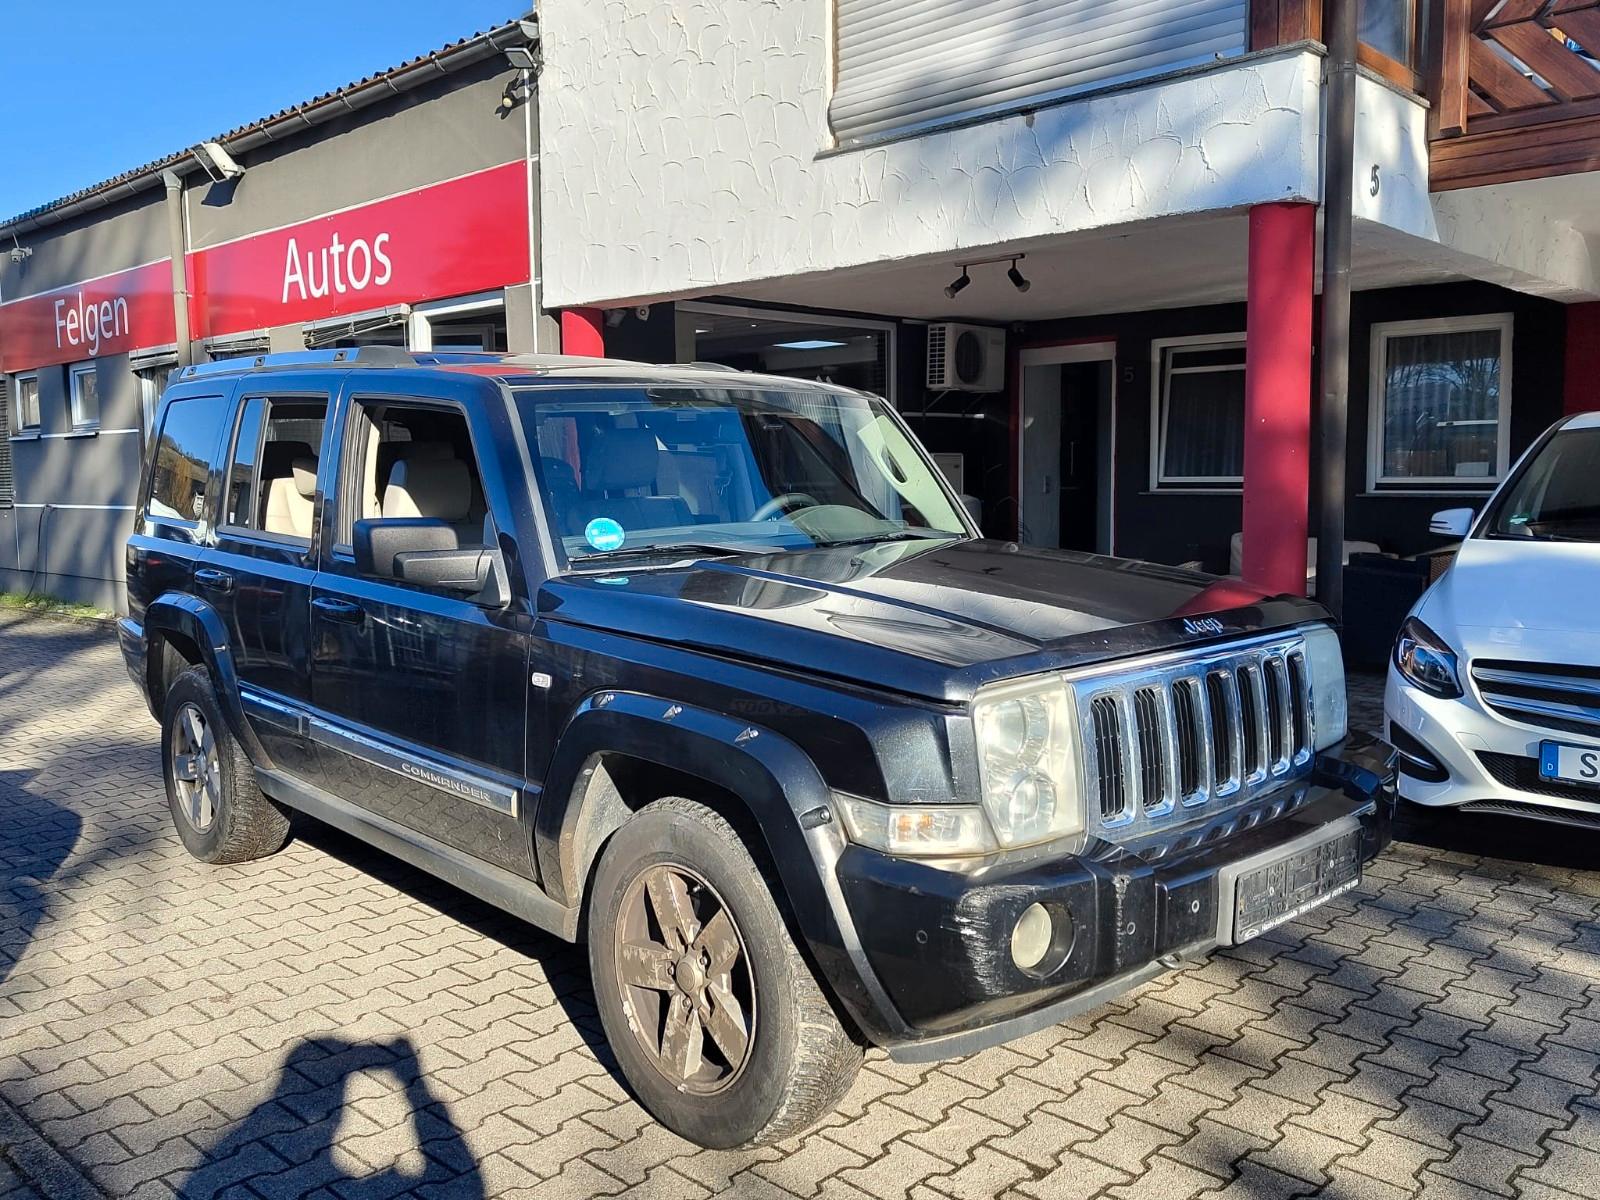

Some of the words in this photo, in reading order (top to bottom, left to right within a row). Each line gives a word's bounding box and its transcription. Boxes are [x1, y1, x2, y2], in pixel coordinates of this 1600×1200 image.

[1369, 163, 1380, 198] 5
[281, 232, 392, 304] Autos
[54, 291, 129, 356] Felgen
[1124, 366, 1135, 383] 5
[1183, 617, 1224, 635] Jeep
[401, 762, 492, 803] COMMANDER
[1547, 762, 1554, 771] D
[1579, 752, 1599, 778] S
